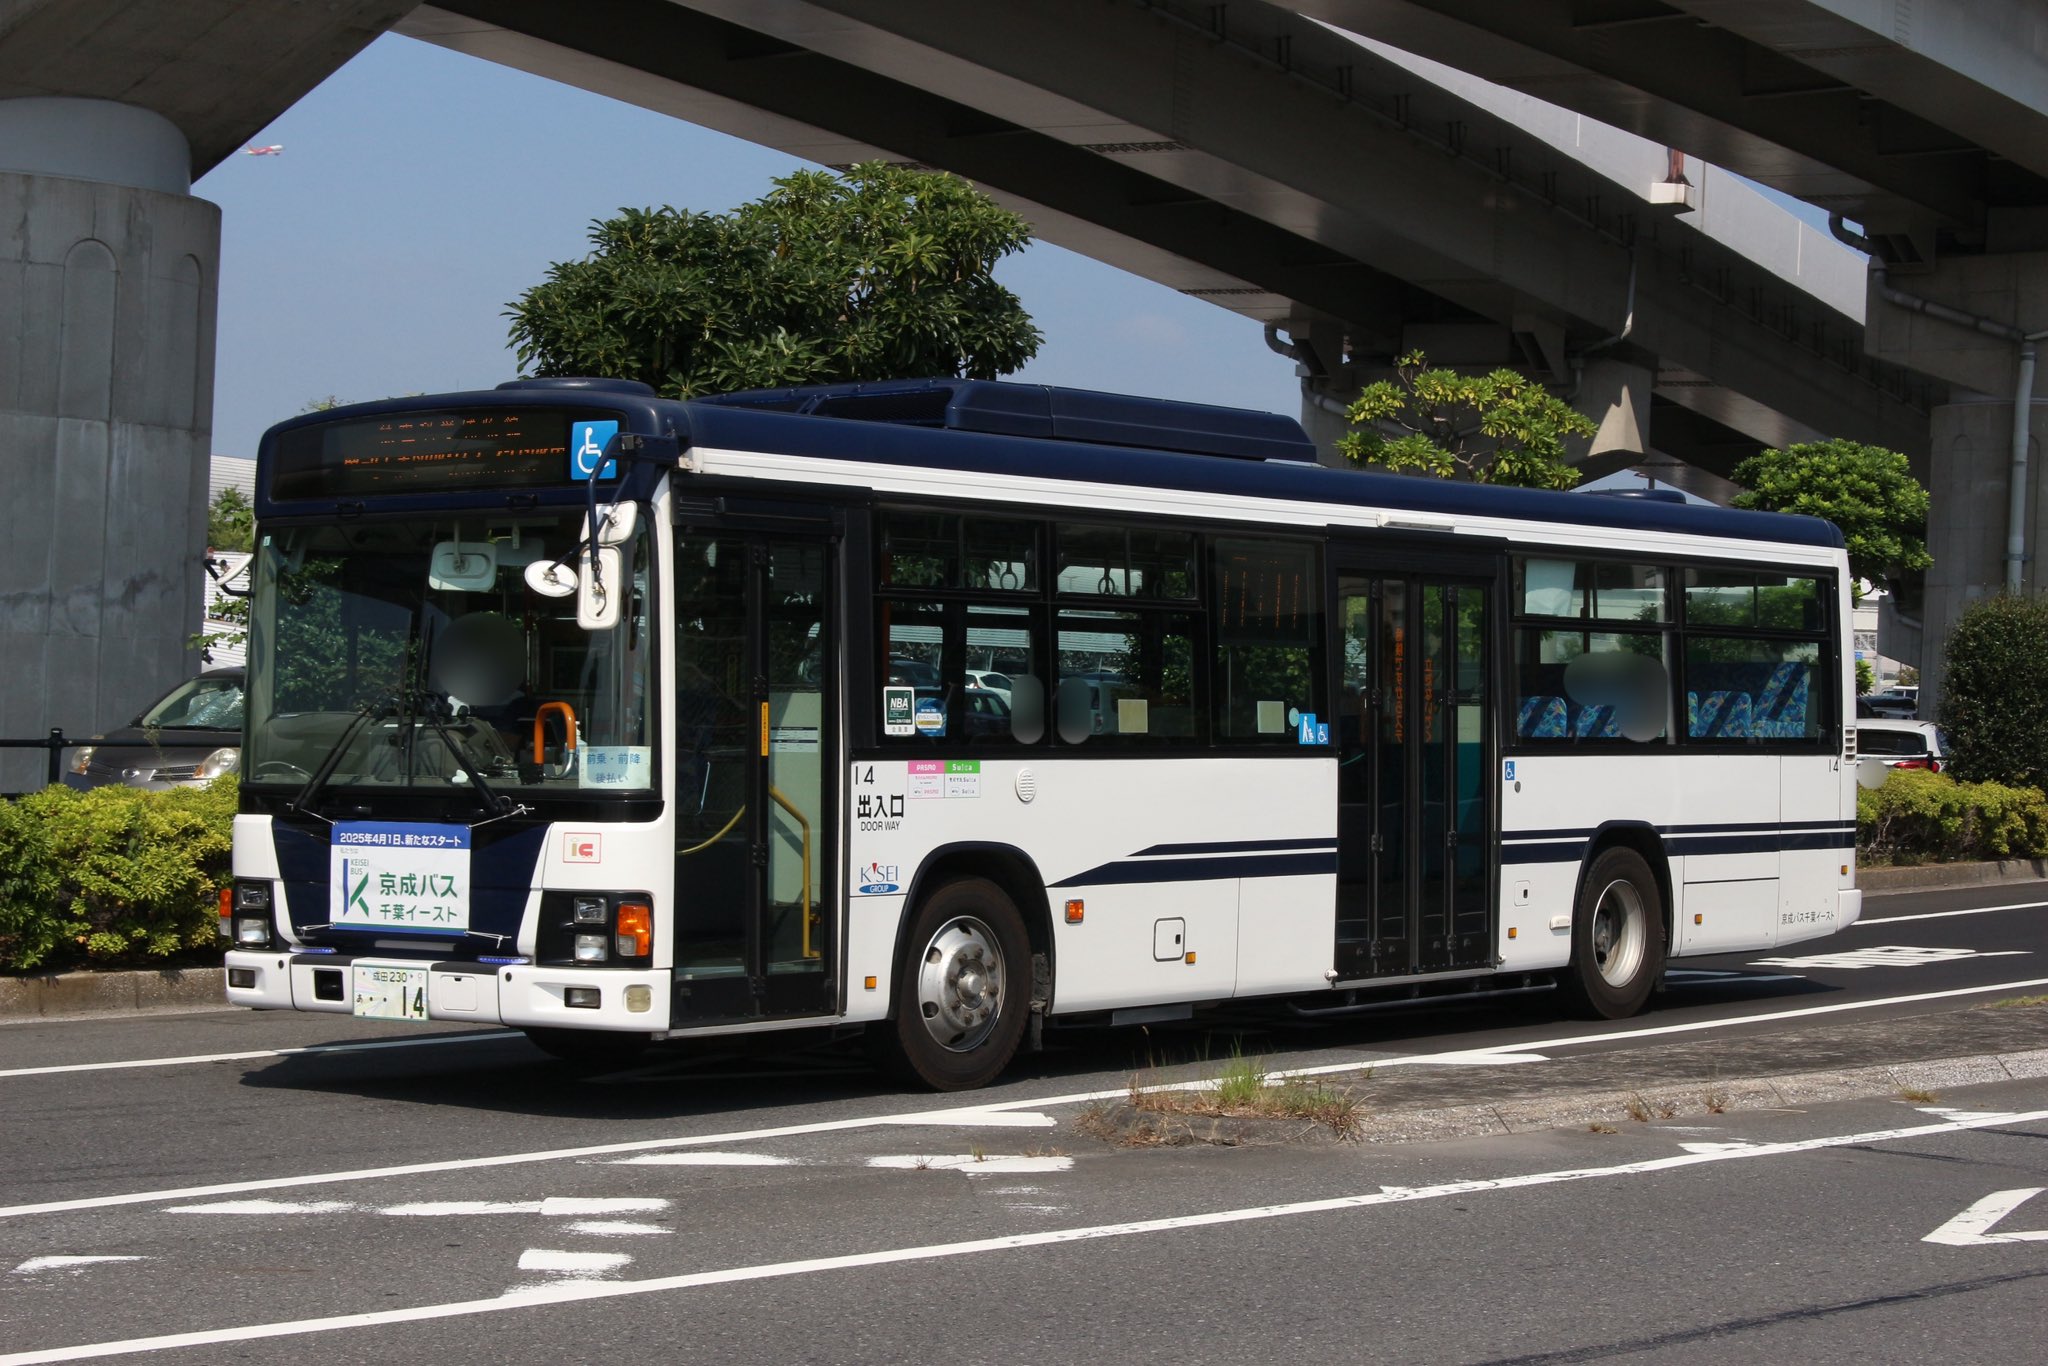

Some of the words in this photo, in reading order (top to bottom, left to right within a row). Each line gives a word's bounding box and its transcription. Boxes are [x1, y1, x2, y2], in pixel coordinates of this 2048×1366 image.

[891, 697, 909, 708] NBA
[952, 763, 972, 771] Suica
[1828, 758, 1839, 772] 14
[596, 773, 629, 784] 後払い
[855, 765, 875, 785] 14
[857, 794, 904, 819] 出入口
[340, 832, 462, 847] 2025年4月1日、新たなスタート
[350, 859, 369, 867] KEISEI
[350, 867, 363, 875] BUS
[379, 872, 458, 898] 京成バス
[869, 885, 889, 893] GROUP
[379, 904, 458, 922] 千葉イースト
[1781, 911, 1835, 925] 京成バス千葉イースト
